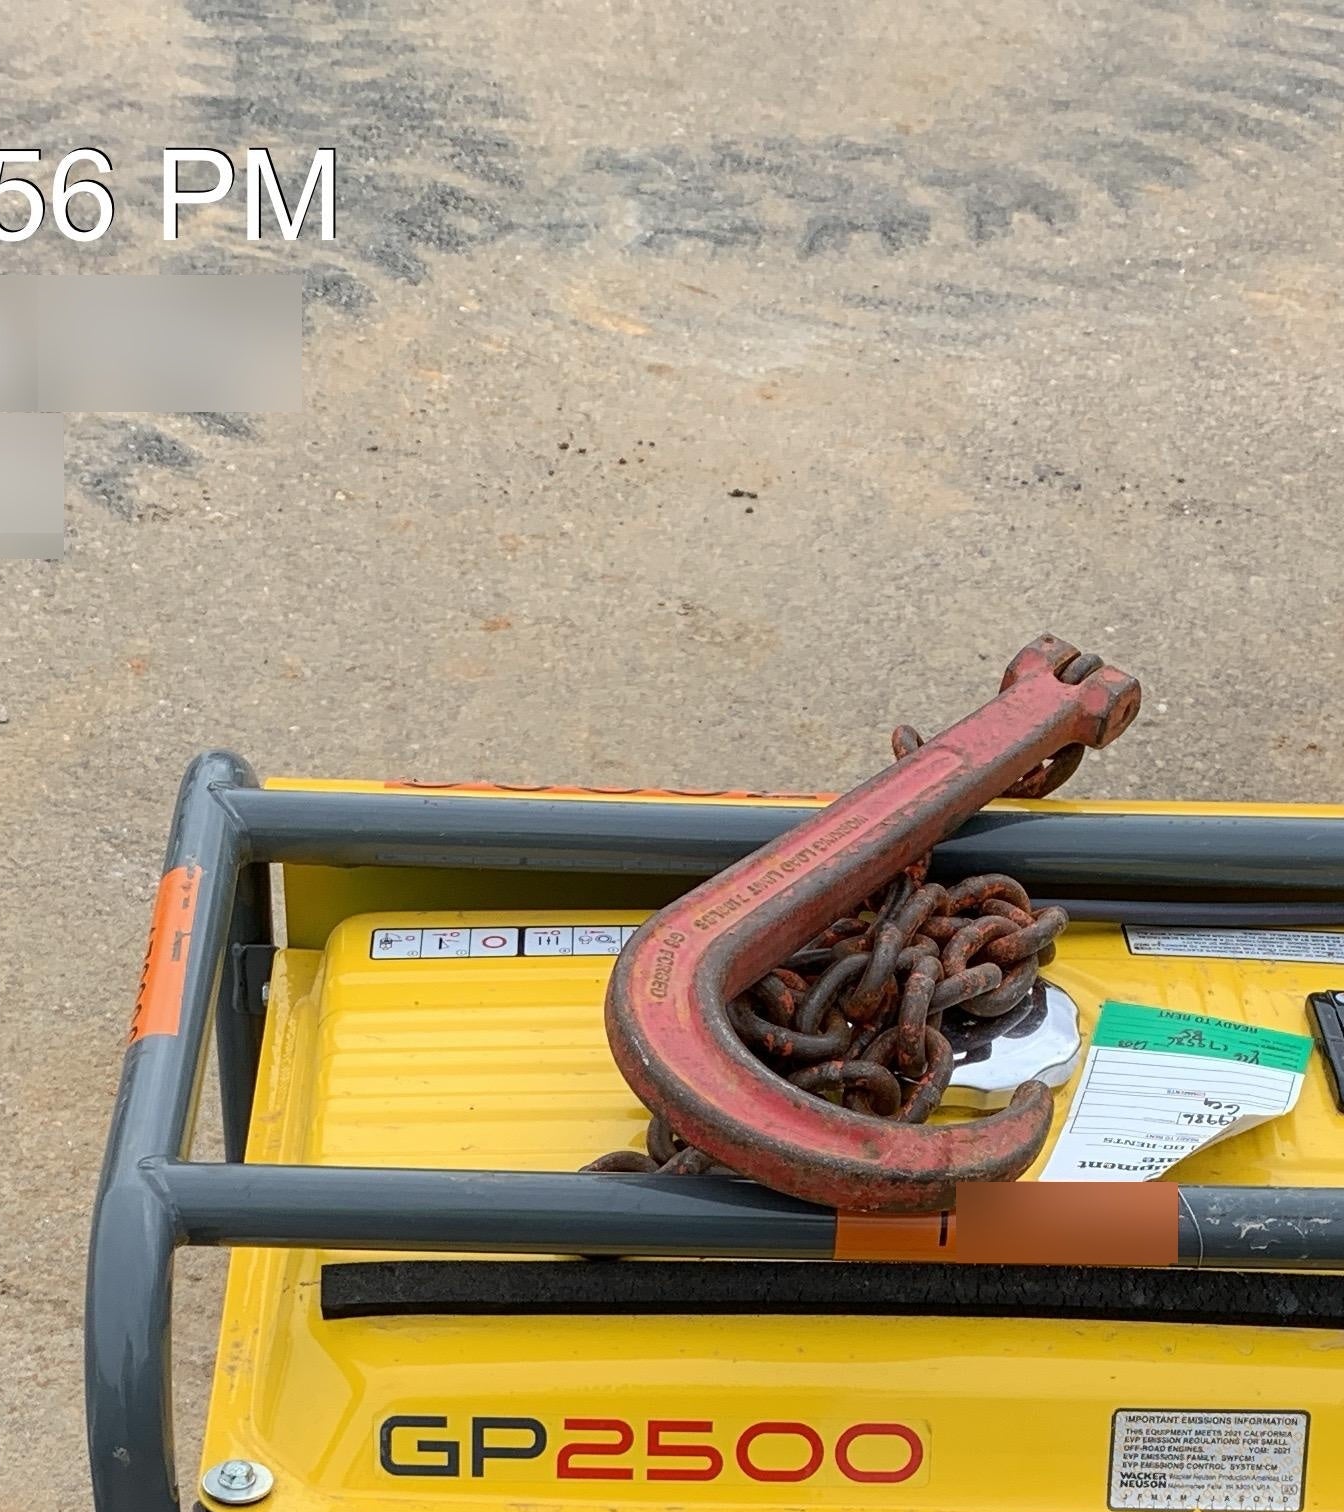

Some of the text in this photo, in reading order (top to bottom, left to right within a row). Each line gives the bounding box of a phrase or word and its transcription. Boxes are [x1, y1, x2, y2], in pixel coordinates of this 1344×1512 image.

[812, 815, 869, 853] WORKING
[779, 847, 817, 873] LOAD
[747, 870, 785, 895] LIMIT
[650, 949, 675, 998] FORGED
[1158, 1010, 1258, 1034] READY TO RENT
[1125, 1416, 1298, 1425] IMPORTANT EMISSIONS INFORMATION
[1183, 1437, 1239, 1445] REGULATIONS
[1261, 1438, 1288, 1446] SMALL
[1244, 1430, 1292, 1438] CALIFORNIA
[379, 1414, 924, 1484] GP2500
[1141, 1453, 1184, 1461] EMISSIONS
[1120, 1472, 1166, 1480] WACKER
[1120, 1480, 1166, 1488] NEUSON
